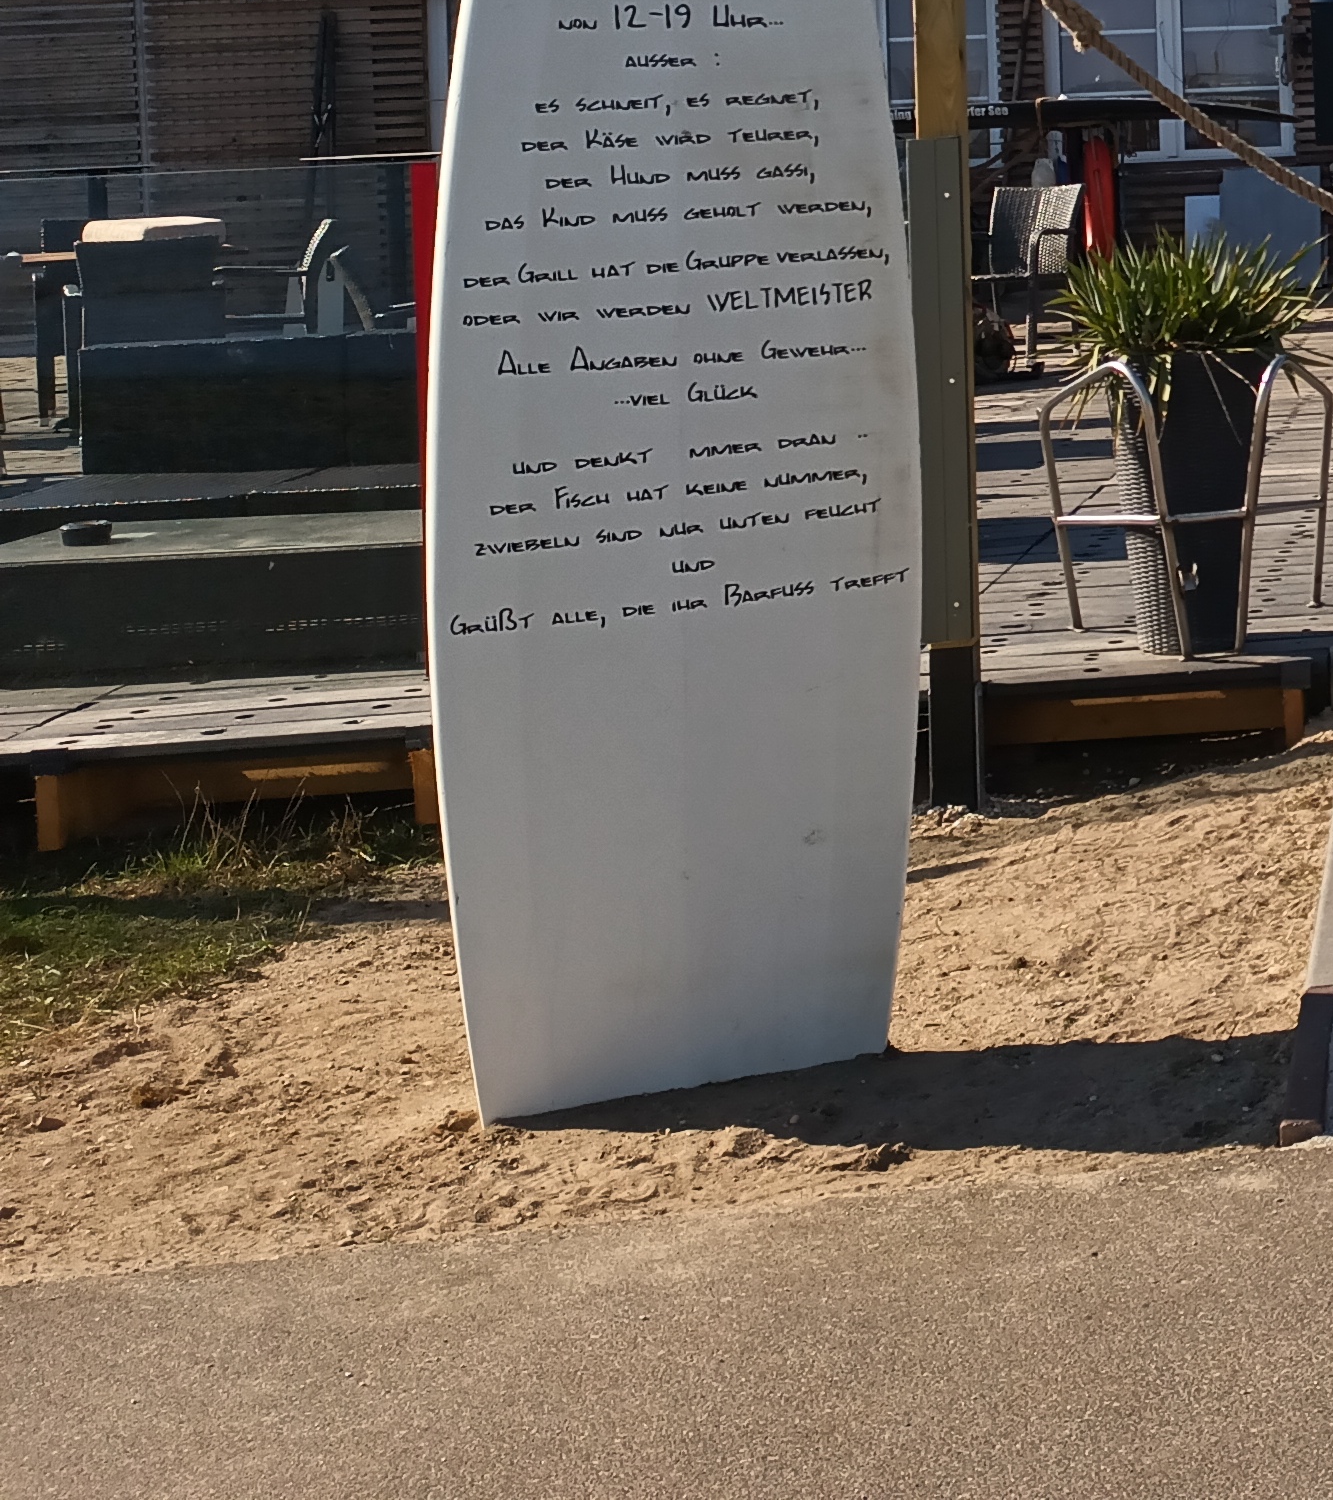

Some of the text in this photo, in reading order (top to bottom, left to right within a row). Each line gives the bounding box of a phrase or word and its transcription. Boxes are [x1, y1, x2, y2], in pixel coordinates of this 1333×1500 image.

[614, 3, 691, 31] 12-19
[534, 88, 819, 117] ES SCHNEIT, ES REGNET,
[520, 128, 819, 153] DER KÄSE WIRD TEURER,
[544, 163, 815, 190] DER HUND MUSS GASSI,
[484, 200, 872, 232] DAS KIND MUSS GEHOLT WERDEN,
[462, 245, 890, 289] DER GRILL HAT DIE GRUPPE VERLASSEN,
[462, 278, 873, 327] ODER WIR WERDEN WELTMEISTER
[497, 349, 552, 376] ALLE
[569, 345, 678, 372] ANGABEN
[693, 351, 745, 365] OHNE
[687, 381, 759, 403] GLÜCK
[512, 461, 558, 475] UND
[574, 447, 654, 470] DENKT
[777, 433, 837, 450] DRAN
[489, 468, 868, 516] DER FISCH HAT KEINE NUMMER,
[474, 497, 882, 557] ZWIEBELN SIND NUR UNTEN FEUCHT
[671, 559, 716, 574] UND
[551, 610, 606, 629] ALLE,
[621, 604, 656, 618] DIE
[671, 599, 708, 613] IHR
[724, 580, 815, 608] BARFUSS
[829, 567, 910, 592] TREFFT
